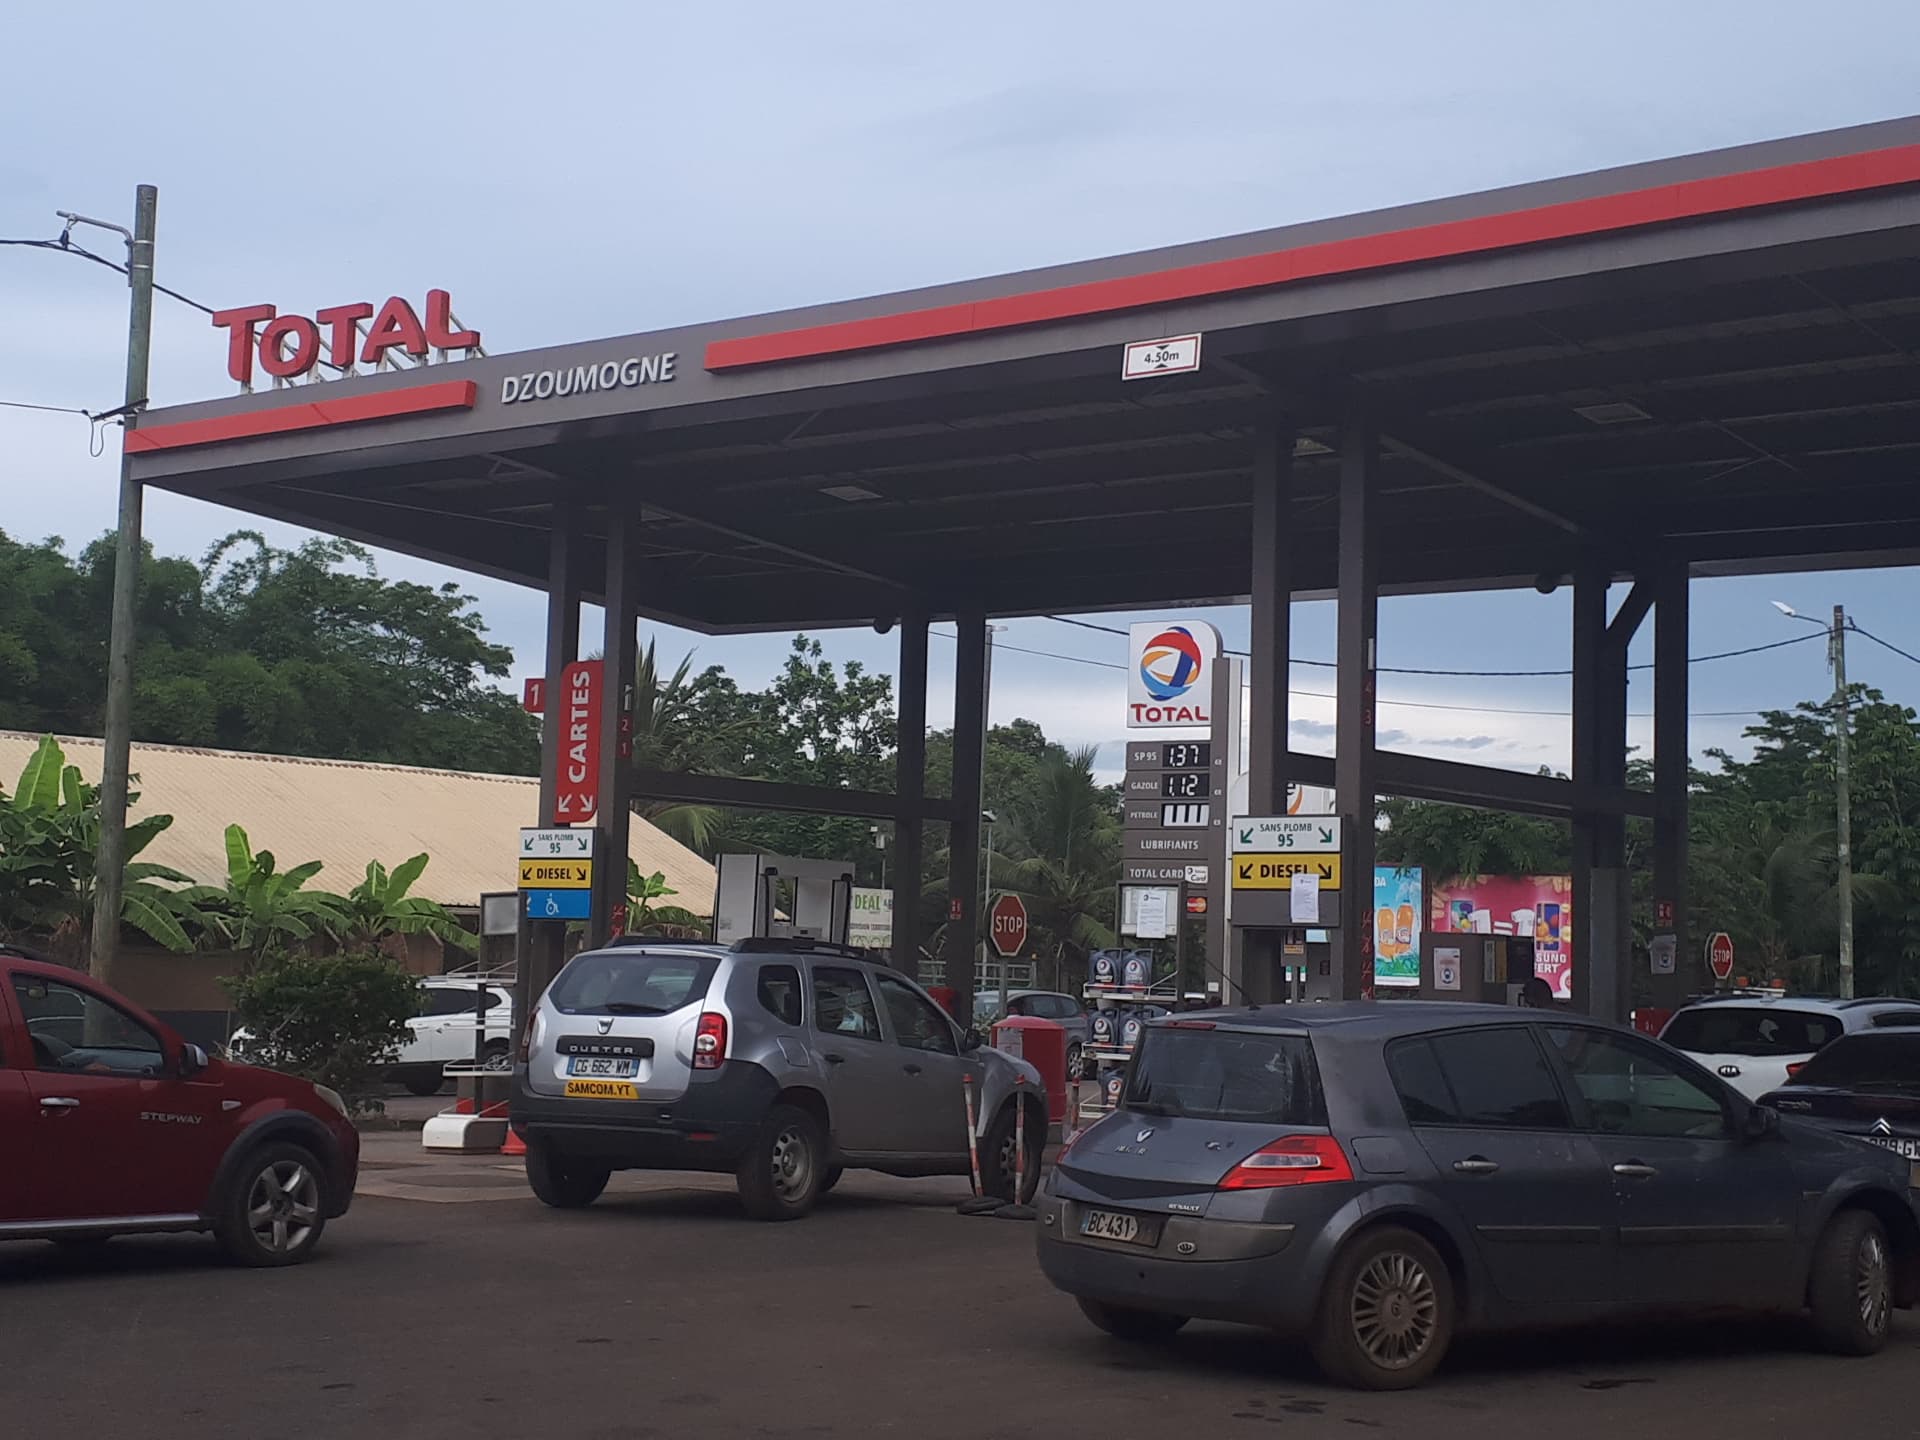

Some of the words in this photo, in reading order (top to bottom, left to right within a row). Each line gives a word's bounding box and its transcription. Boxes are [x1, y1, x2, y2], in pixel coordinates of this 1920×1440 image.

[212, 289, 480, 383] TOTAL
[1144, 350, 1180, 363] 4.50m
[501, 353, 676, 403] DZOUMOGNE
[531, 684, 540, 706] 1
[1130, 703, 1209, 722] TOTAL
[568, 671, 590, 783] CARTES
[1169, 745, 1199, 767] 1.37
[1130, 781, 1158, 790] GAZOLE
[1169, 775, 1198, 796] 1.12
[1260, 823, 1281, 832] SANS
[1284, 823, 1312, 832] PLOMB
[538, 833, 553, 841] SANS
[1278, 834, 1294, 847] 95
[550, 842, 561, 853] 95
[1140, 839, 1199, 850] LUBRIFIANTS
[537, 868, 572, 880] DIESEL
[1129, 868, 1157, 878] TOTAL
[1159, 869, 1184, 879] CARD
[855, 894, 881, 910] DEAL
[995, 915, 1023, 933] STOP
[1713, 950, 1730, 962] STOP
[569, 1045, 633, 1054] DUSTER
[568, 1082, 632, 1096] SAMCOM.YT
[140, 1111, 202, 1124] STEPWAY
